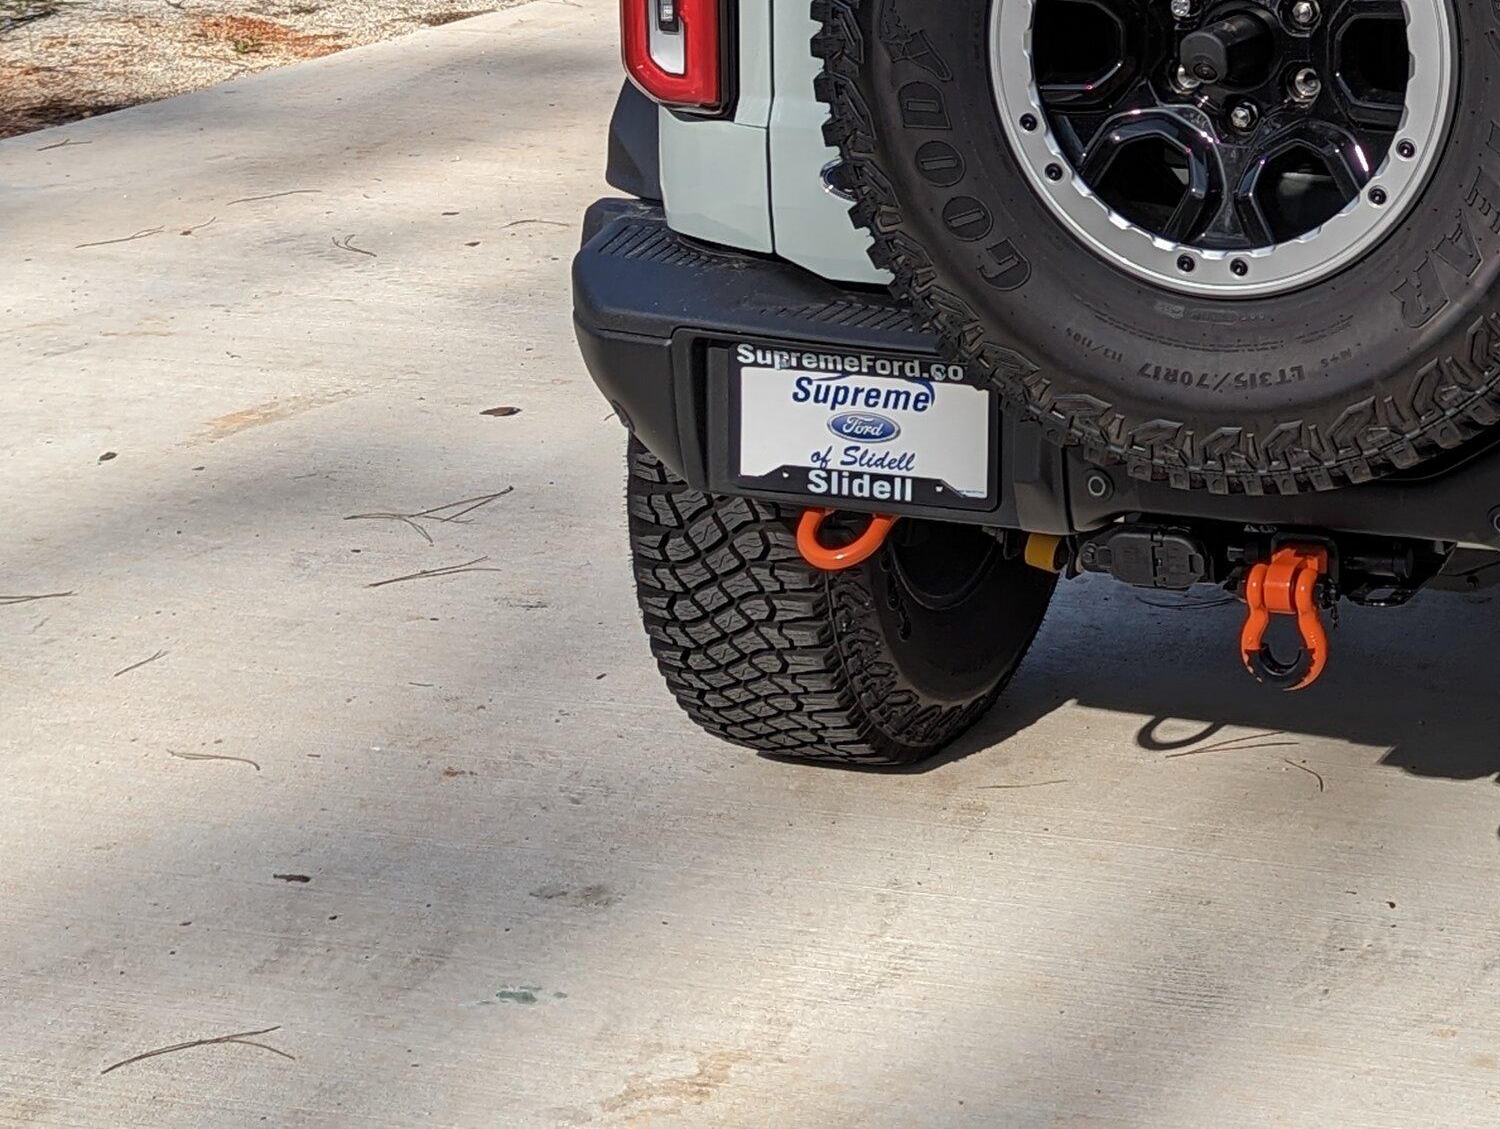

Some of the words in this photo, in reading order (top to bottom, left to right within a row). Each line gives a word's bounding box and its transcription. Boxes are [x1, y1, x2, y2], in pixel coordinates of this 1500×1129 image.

[736, 343, 968, 382] SupremeFord.co
[791, 376, 931, 413] Supreme
[810, 445, 834, 470] of
[839, 445, 916, 472] Slidell
[806, 470, 913, 502] Slidell
